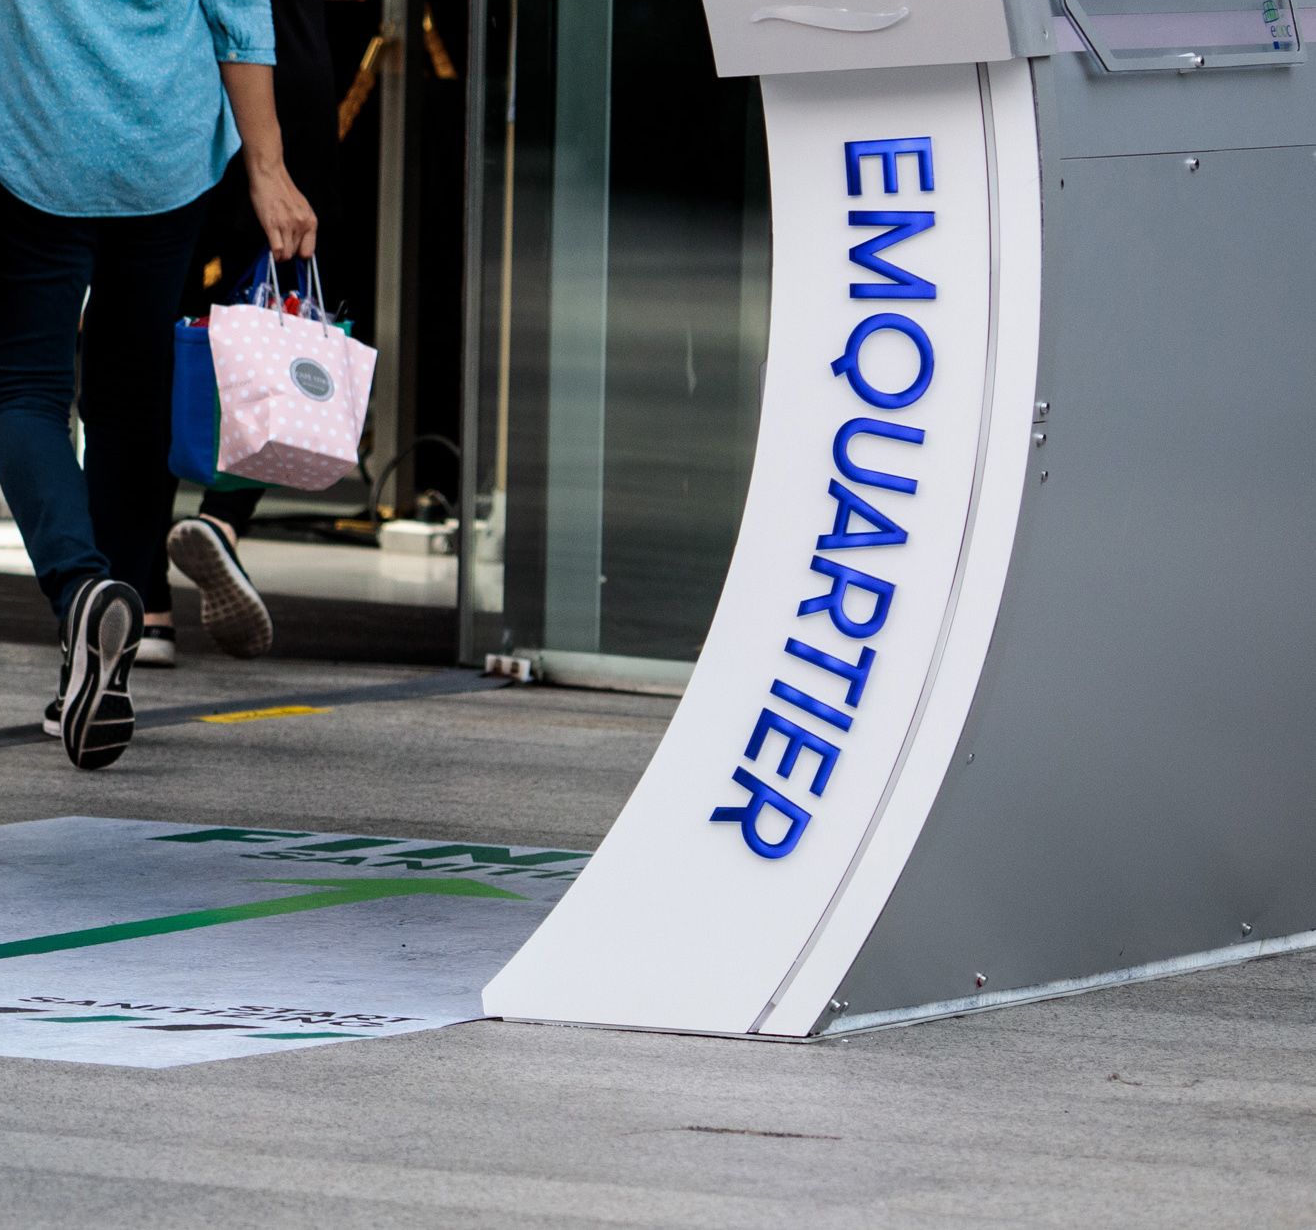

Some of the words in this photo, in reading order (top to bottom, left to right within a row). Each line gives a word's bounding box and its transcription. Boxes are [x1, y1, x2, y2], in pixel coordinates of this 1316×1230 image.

[707, 134, 937, 864] EMQUARTIER
[17, 995, 387, 1028] SANITIZING
[226, 1004, 426, 1023] START
